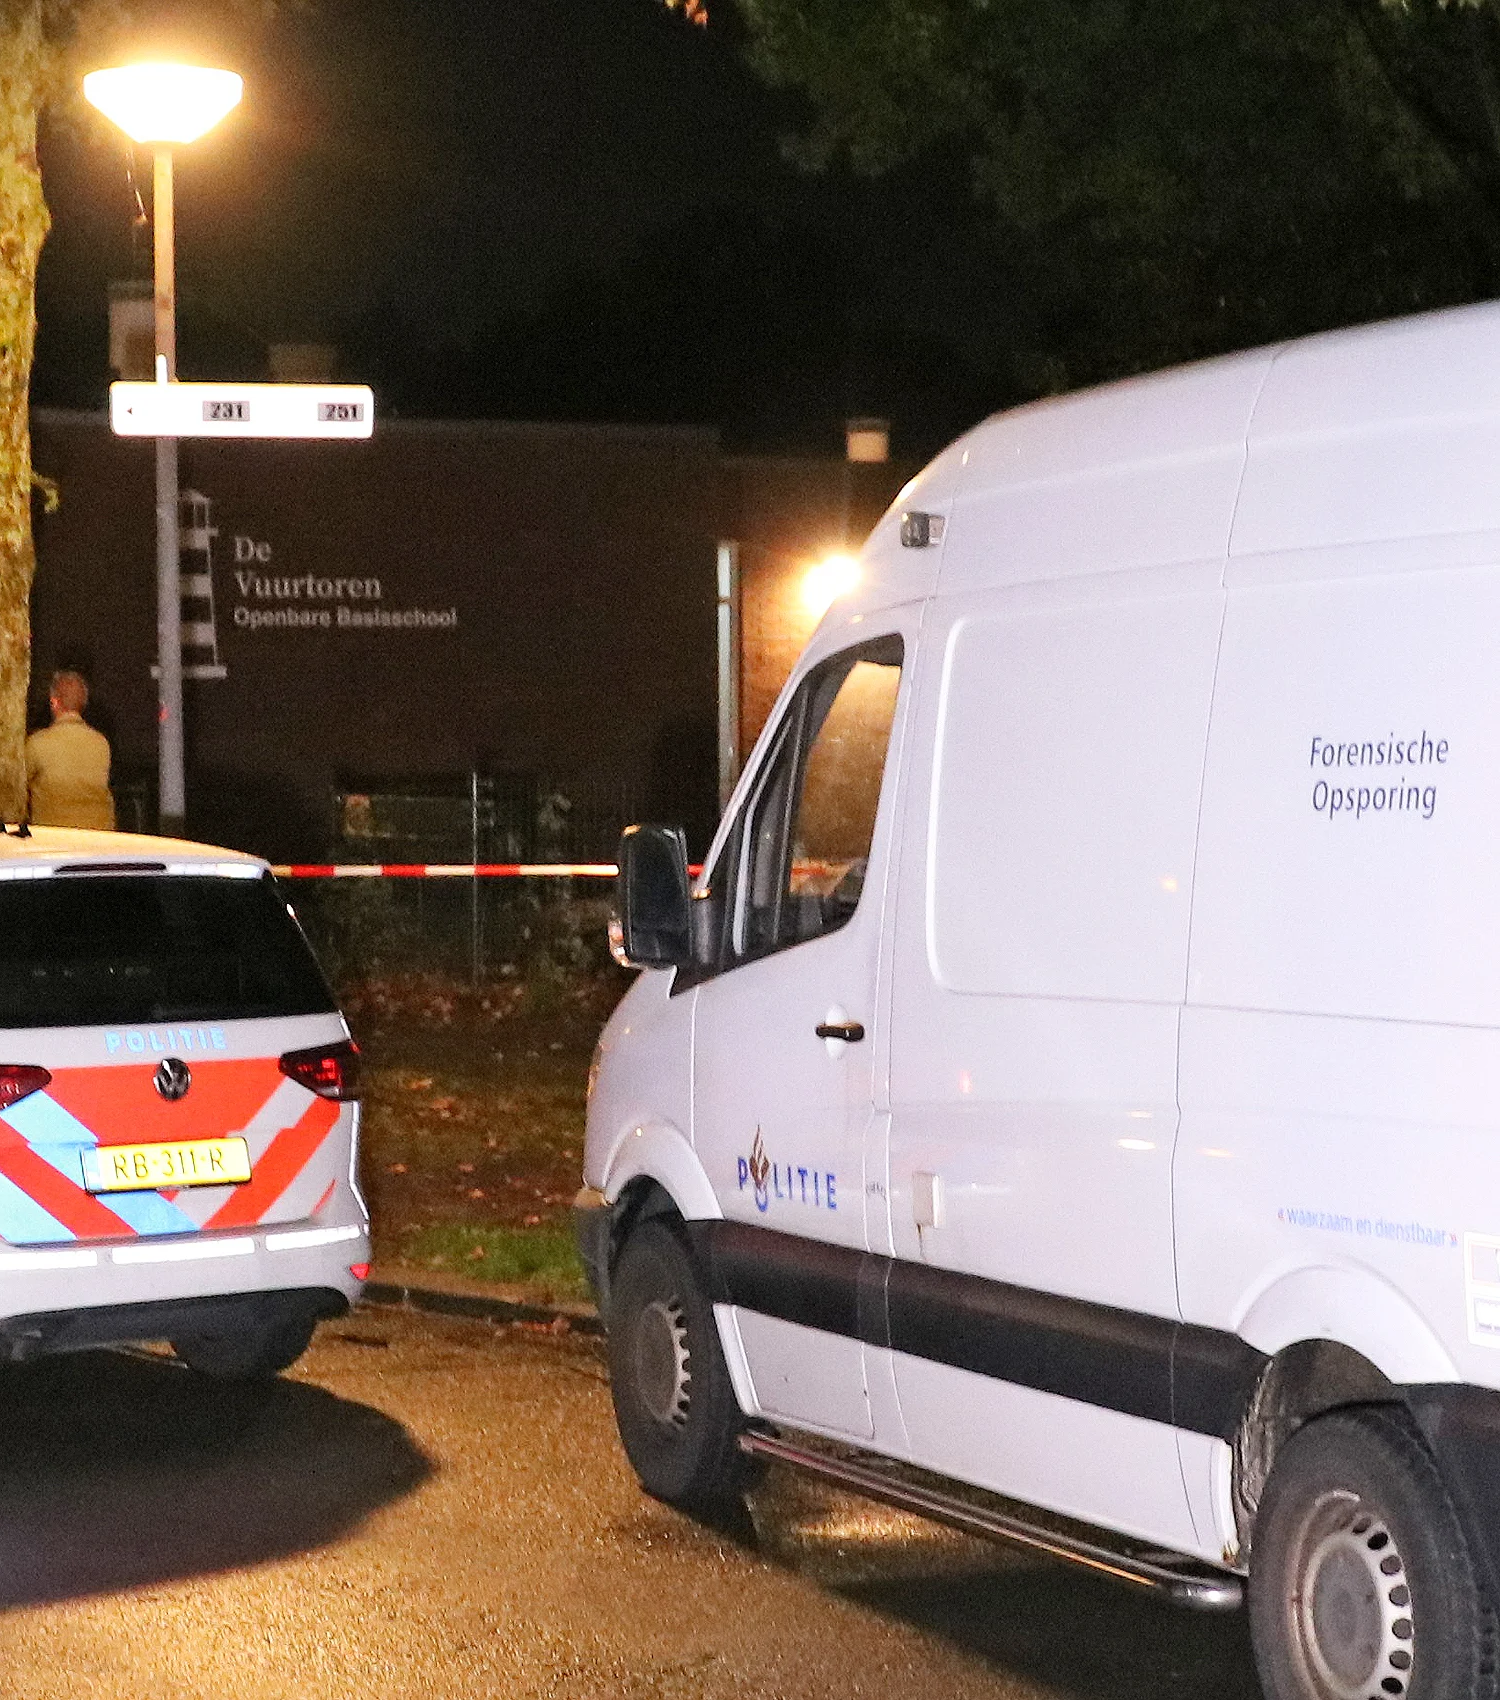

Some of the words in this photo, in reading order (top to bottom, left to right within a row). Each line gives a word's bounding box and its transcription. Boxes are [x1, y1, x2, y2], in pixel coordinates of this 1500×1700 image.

[210, 402, 243, 420] 231
[234, 536, 272, 562] De
[234, 571, 382, 599] Vuurtoren
[233, 606, 331, 629] Openbare
[337, 606, 458, 628] Basisschool
[1310, 729, 1450, 768] Forensische
[1312, 777, 1438, 821] Opsporing
[104, 1026, 227, 1054] POLITIE
[113, 1147, 226, 1181] RB-311-R
[737, 1155, 838, 1213] POLITIE
[1287, 1207, 1353, 1234] waakzaam
[1356, 1217, 1372, 1236] en
[1375, 1219, 1447, 1247] dienstbaar
